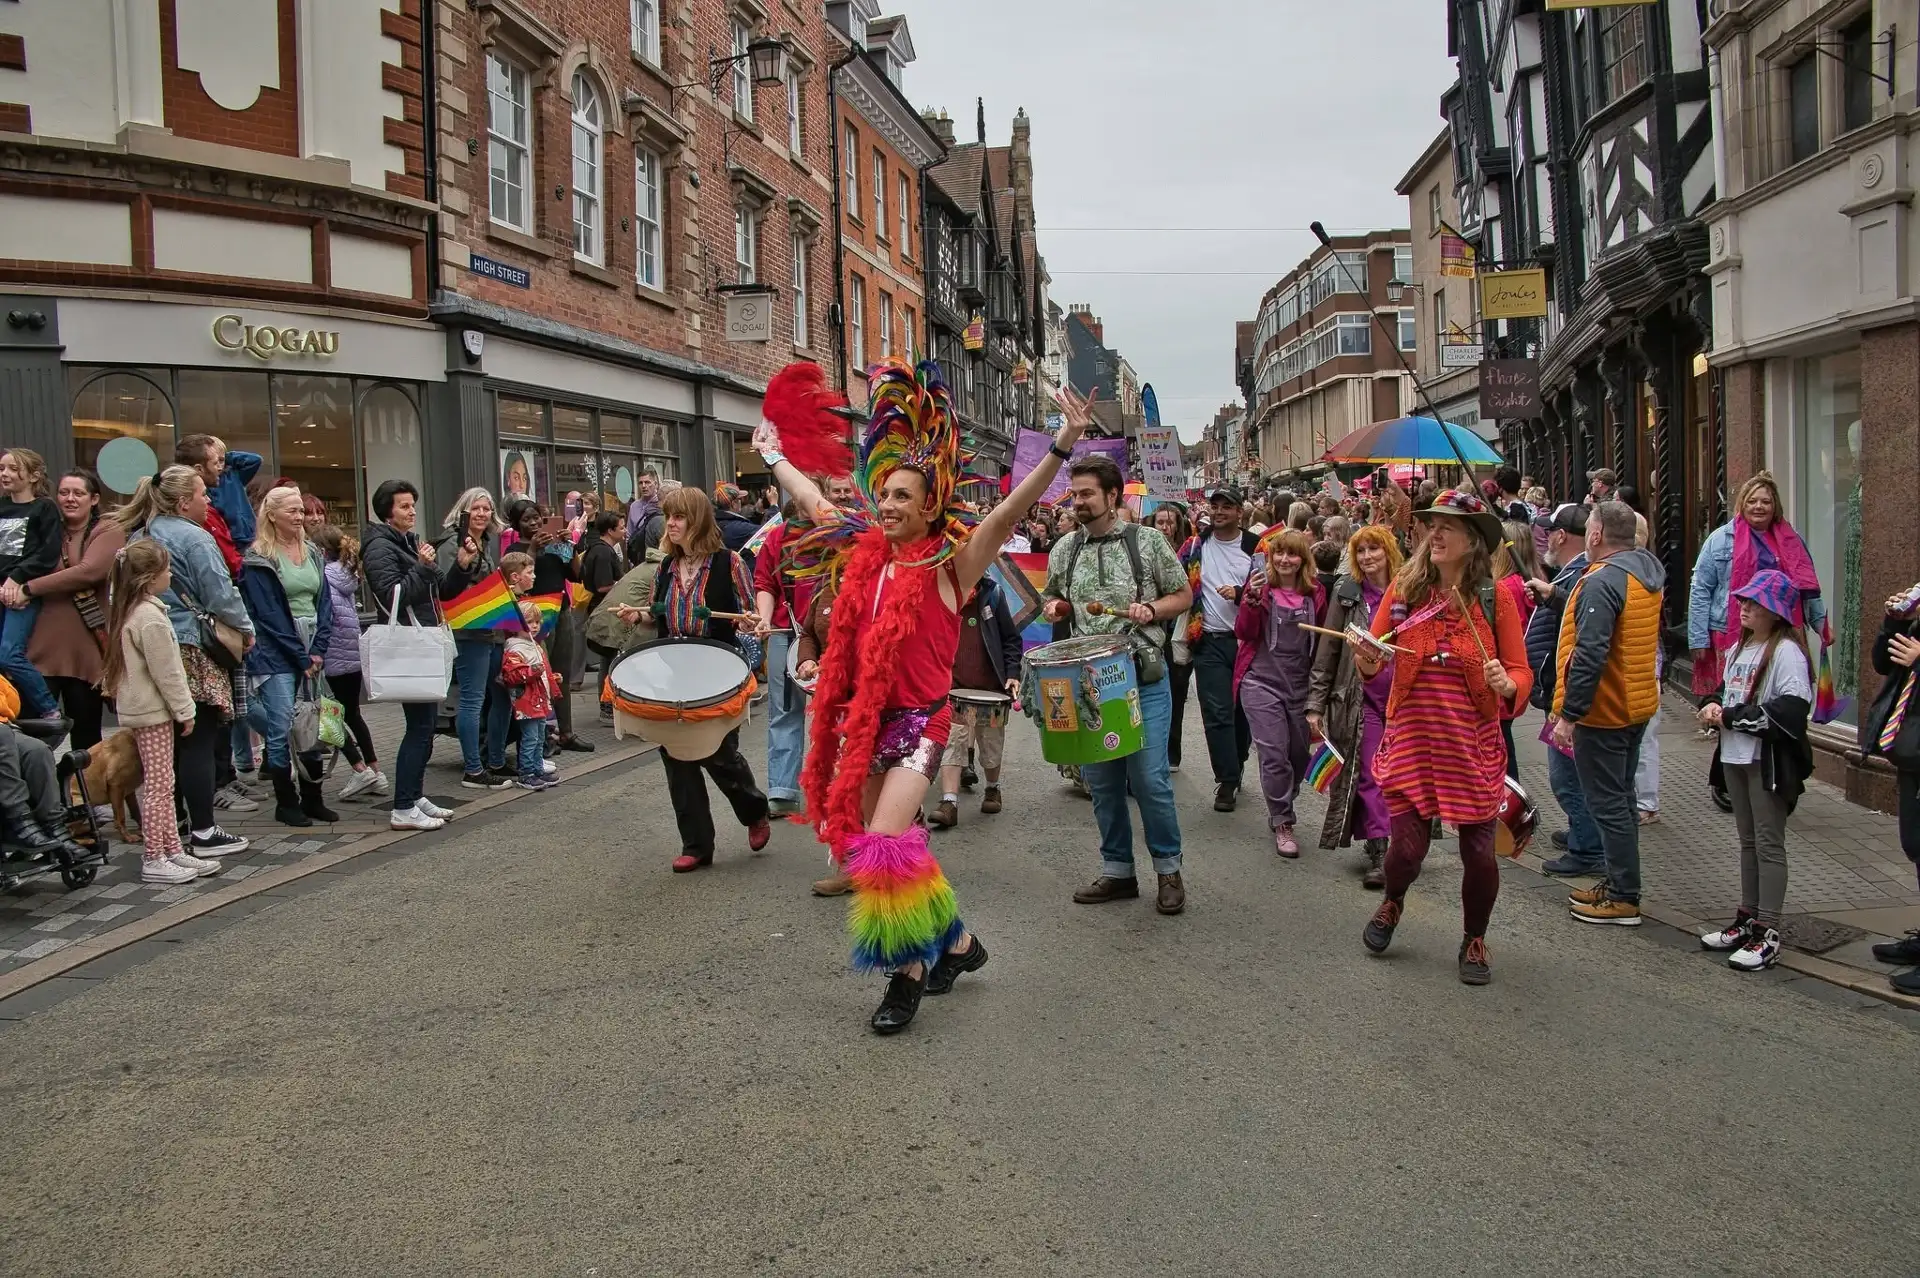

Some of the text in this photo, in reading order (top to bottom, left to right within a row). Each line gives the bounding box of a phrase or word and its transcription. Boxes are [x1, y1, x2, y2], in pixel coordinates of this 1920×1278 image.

[474, 258, 526, 285] HIGH STREET
[731, 322, 765, 334] CLOGAU
[213, 314, 340, 360] CLOGAU
[1101, 664, 1118, 675] NON
[1095, 671, 1126, 687] VIOLENT
[1051, 719, 1070, 729] NOW
